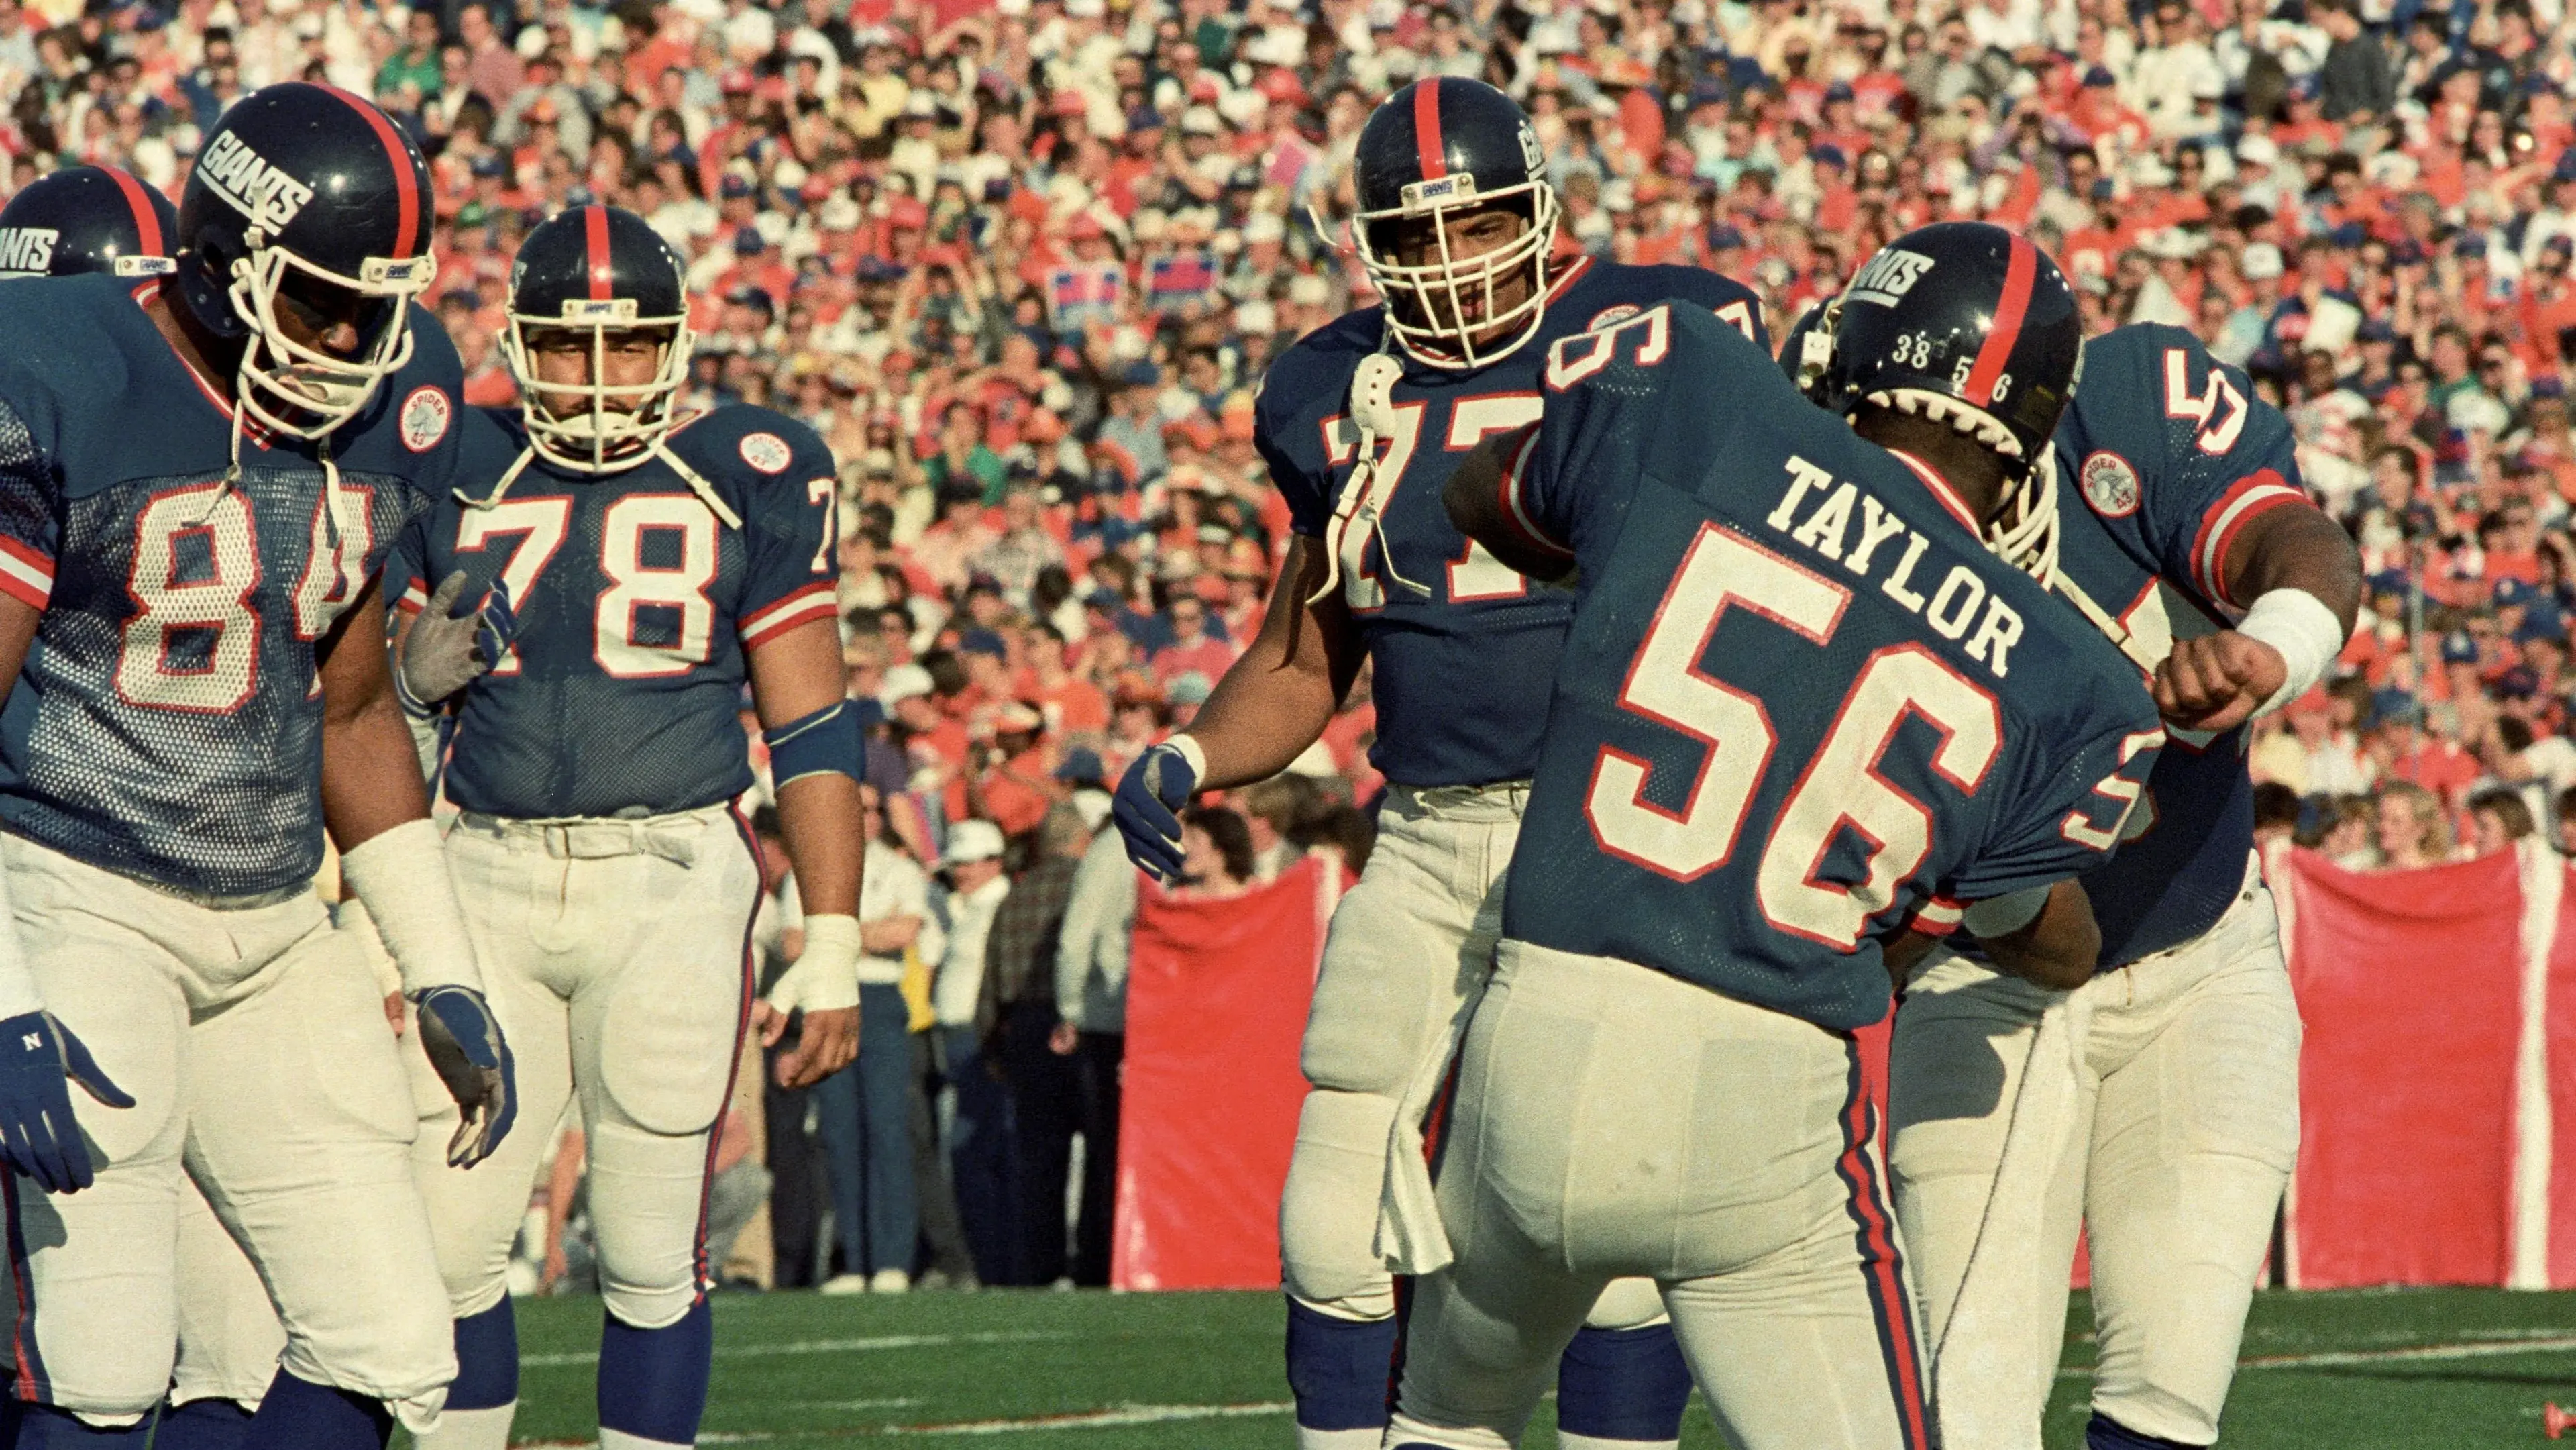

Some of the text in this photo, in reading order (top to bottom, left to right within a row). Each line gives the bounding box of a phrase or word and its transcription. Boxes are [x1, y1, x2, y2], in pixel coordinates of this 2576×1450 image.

[203, 130, 314, 226] GIANTS
[1422, 179, 1453, 197] GIANTS
[1892, 335, 1930, 369] 38
[1951, 356, 2012, 403] 56
[411, 393, 445, 416] SPIDER
[412, 431, 427, 446] 43
[2086, 458, 2117, 488] SPIDER
[2116, 490, 2133, 510] 43
[1766, 455, 2025, 678] TAYLOR
[453, 493, 720, 679] 78
[1583, 519, 2004, 953] 56
[21, 1031, 42, 1051] N
